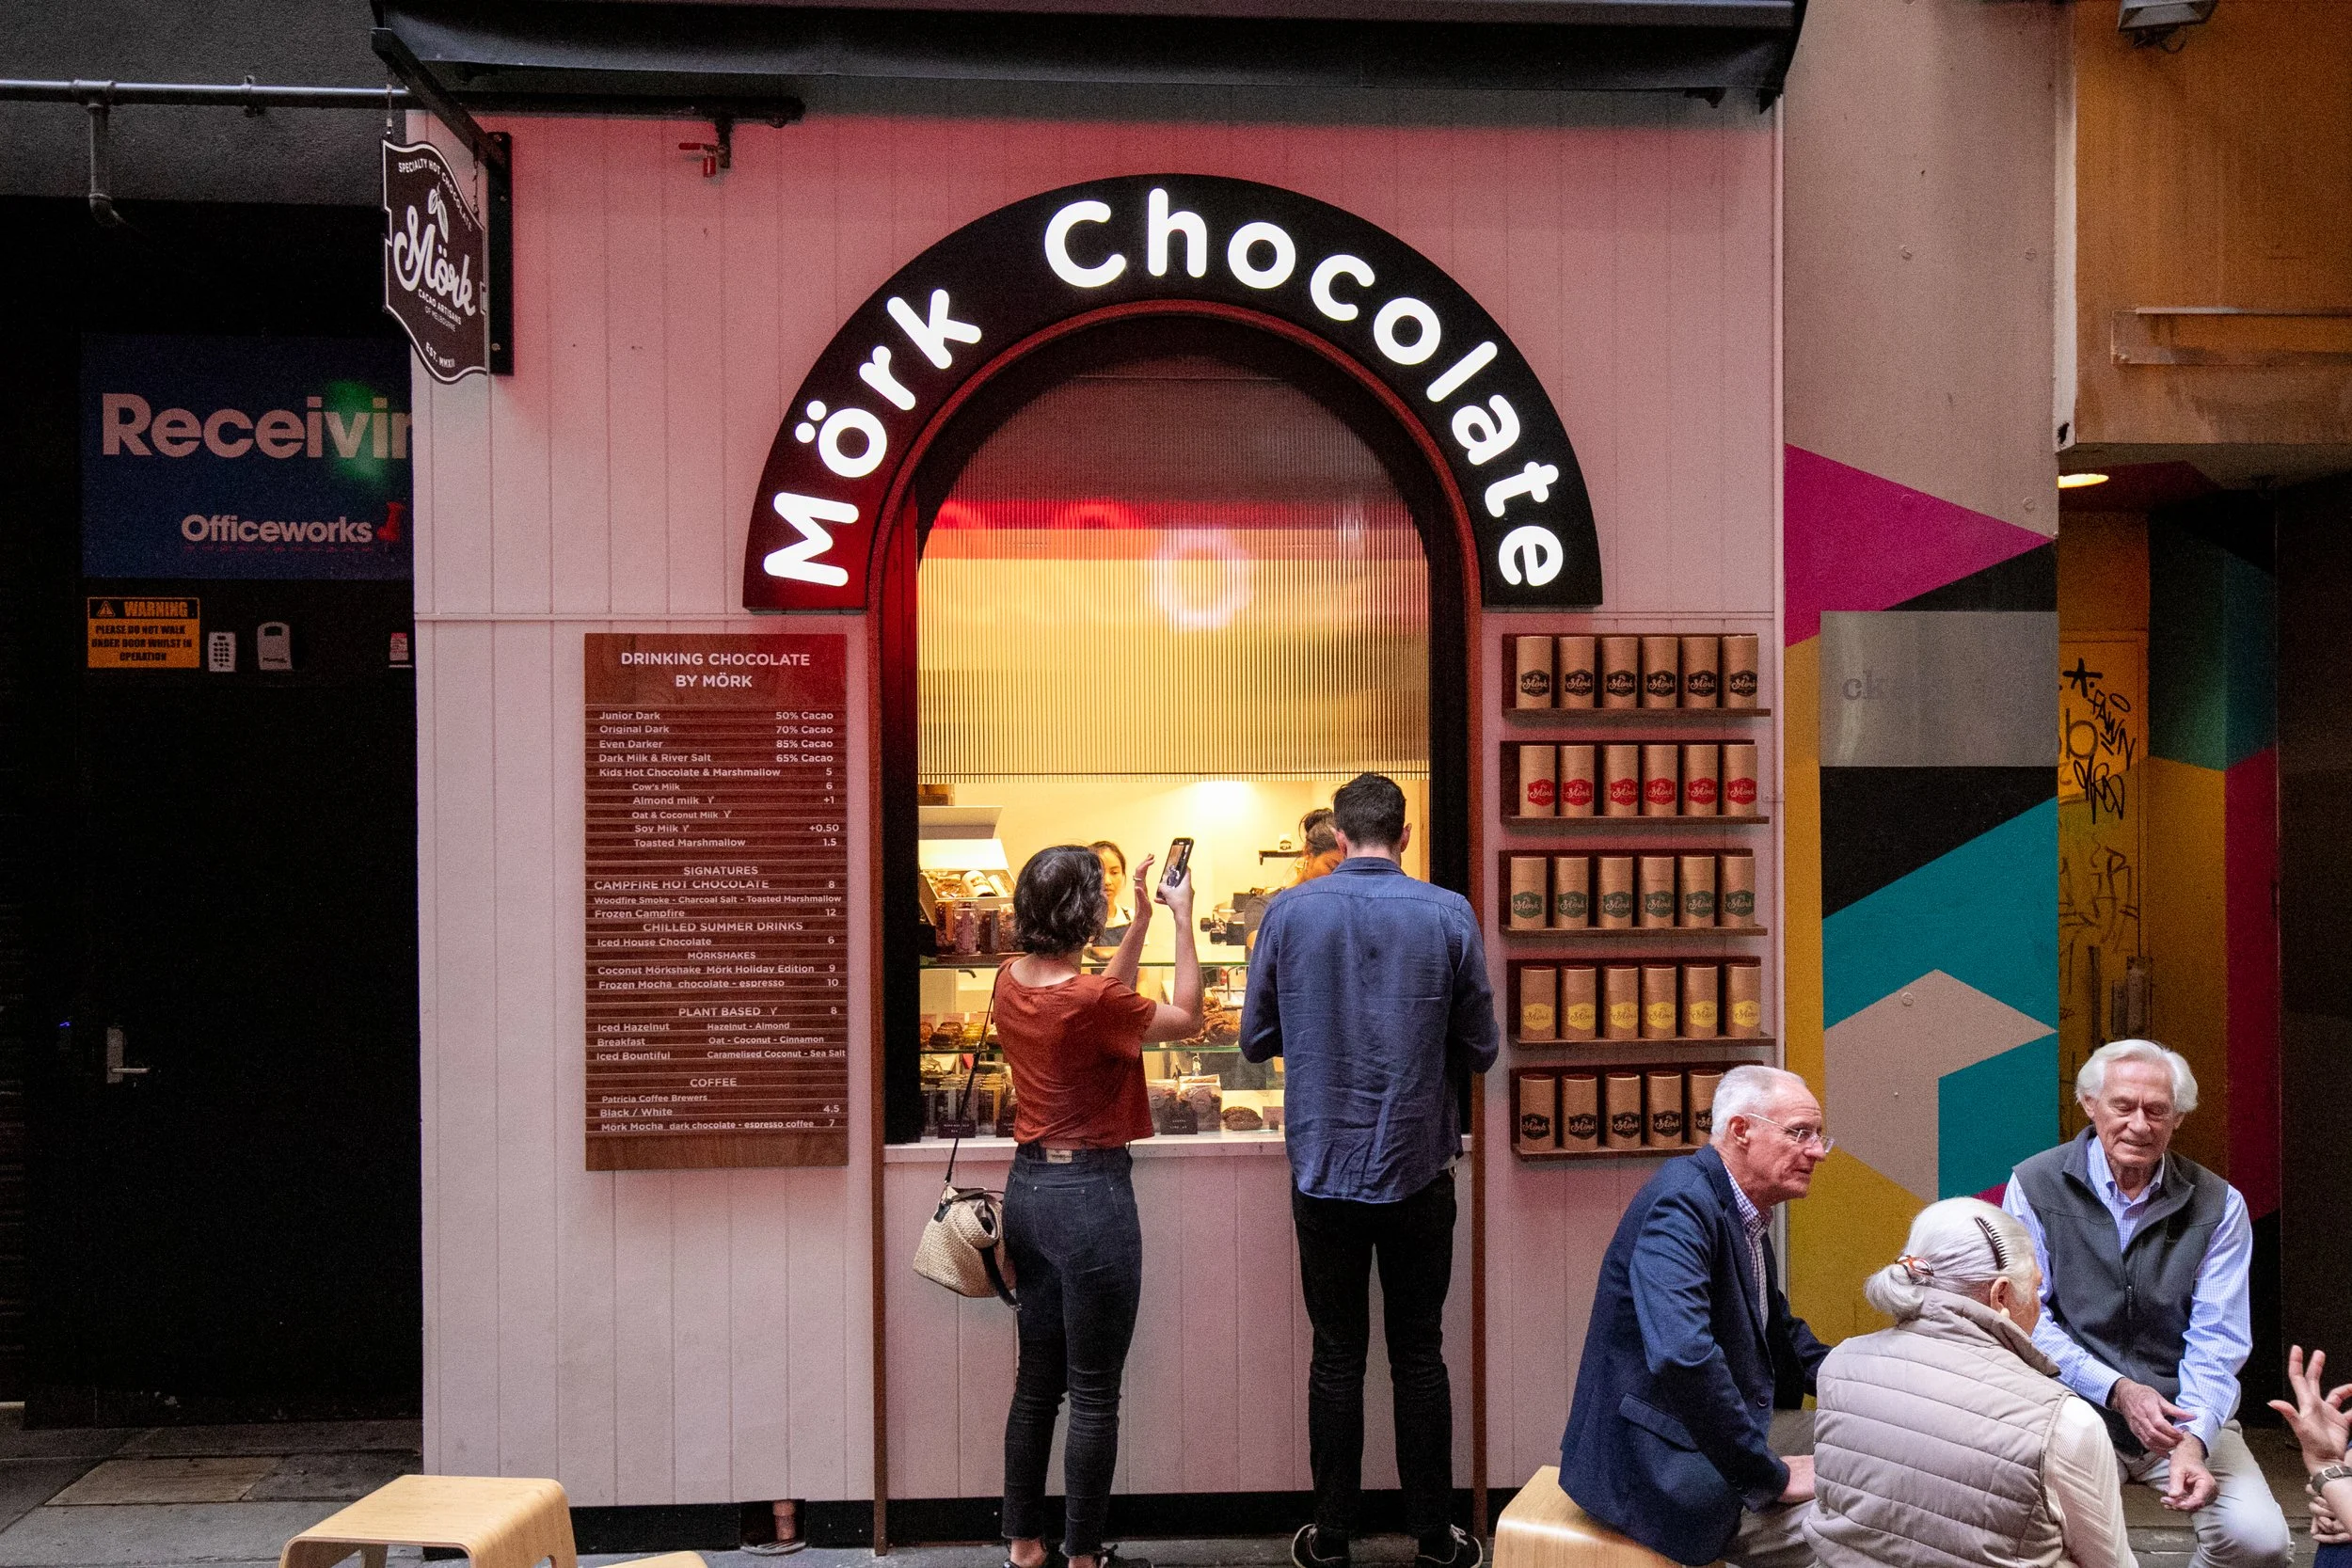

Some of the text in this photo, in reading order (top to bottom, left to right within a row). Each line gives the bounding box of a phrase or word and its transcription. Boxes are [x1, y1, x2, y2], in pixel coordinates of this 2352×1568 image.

[398, 158, 472, 231] SPECIALTY HOT CHOCOLATE
[393, 205, 476, 317] Mörk
[418, 289, 461, 325] CACAO ARTISANS
[763, 188, 1564, 587] Mörk Chocolate
[181, 514, 373, 543] Officeworks
[124, 601, 188, 617] WARNING
[621, 653, 811, 667] DRINKING CHOCOLATE
[675, 672, 753, 688] BY MÖRK
[775, 712, 799, 721] 50%
[802, 712, 834, 721] Cacao
[599, 725, 642, 735] Original
[776, 725, 799, 734] 70%
[802, 725, 834, 734] Cacao
[599, 740, 834, 749] Even Darker 85% Cacao
[627, 753, 648, 762] Milk
[650, 753, 658, 762] &
[661, 753, 688, 762] River
[691, 753, 711, 762] Salt
[776, 754, 799, 763] 65%
[802, 754, 834, 763] Cacao
[599, 768, 833, 777] Kids Hot Chocolate & Marshmallow 5
[632, 782, 833, 791] Cow's Milk 6
[823, 796, 834, 804] +1
[634, 824, 839, 833] Soy Milk +0.50
[633, 838, 836, 847] Toasted Marshmallow 1.5
[683, 866, 758, 876] SIGNATURES
[594, 880, 834, 890] CAMPFIRE HOT CHOCOLATE 8
[678, 895, 718, 904] Charcoal
[784, 895, 842, 903] Marshmallow
[595, 909, 836, 918] Frozen Campfire 12
[643, 922, 803, 932] CHILLED SUMMER DRINKS
[623, 938, 656, 946] House
[659, 938, 712, 946] Chocolate
[828, 936, 834, 944] 6
[597, 966, 643, 974] Coconut
[735, 965, 775, 974] Holiday
[777, 964, 815, 974] Edition
[829, 964, 835, 973] 9
[598, 981, 635, 990] Frozen
[638, 980, 673, 989] Mocha
[739, 979, 785, 988] espresso
[827, 978, 838, 987] 10
[678, 1006, 837, 1017] PLANT BASED 8
[597, 1023, 620, 1032] Iced
[624, 1022, 670, 1032] Hazelnut
[597, 1037, 645, 1046] Breakfast
[779, 1036, 824, 1044] Cinnamon
[596, 1053, 619, 1061] Iced
[622, 1052, 671, 1060] Bountiful
[764, 1050, 802, 1058] Coconut
[690, 1078, 738, 1087] COFFEE
[600, 1104, 840, 1117] Black / White 4.5
[629, 1122, 663, 1131] Mocha
[691, 1121, 736, 1130] chocolate
[786, 1120, 814, 1129] coffee
